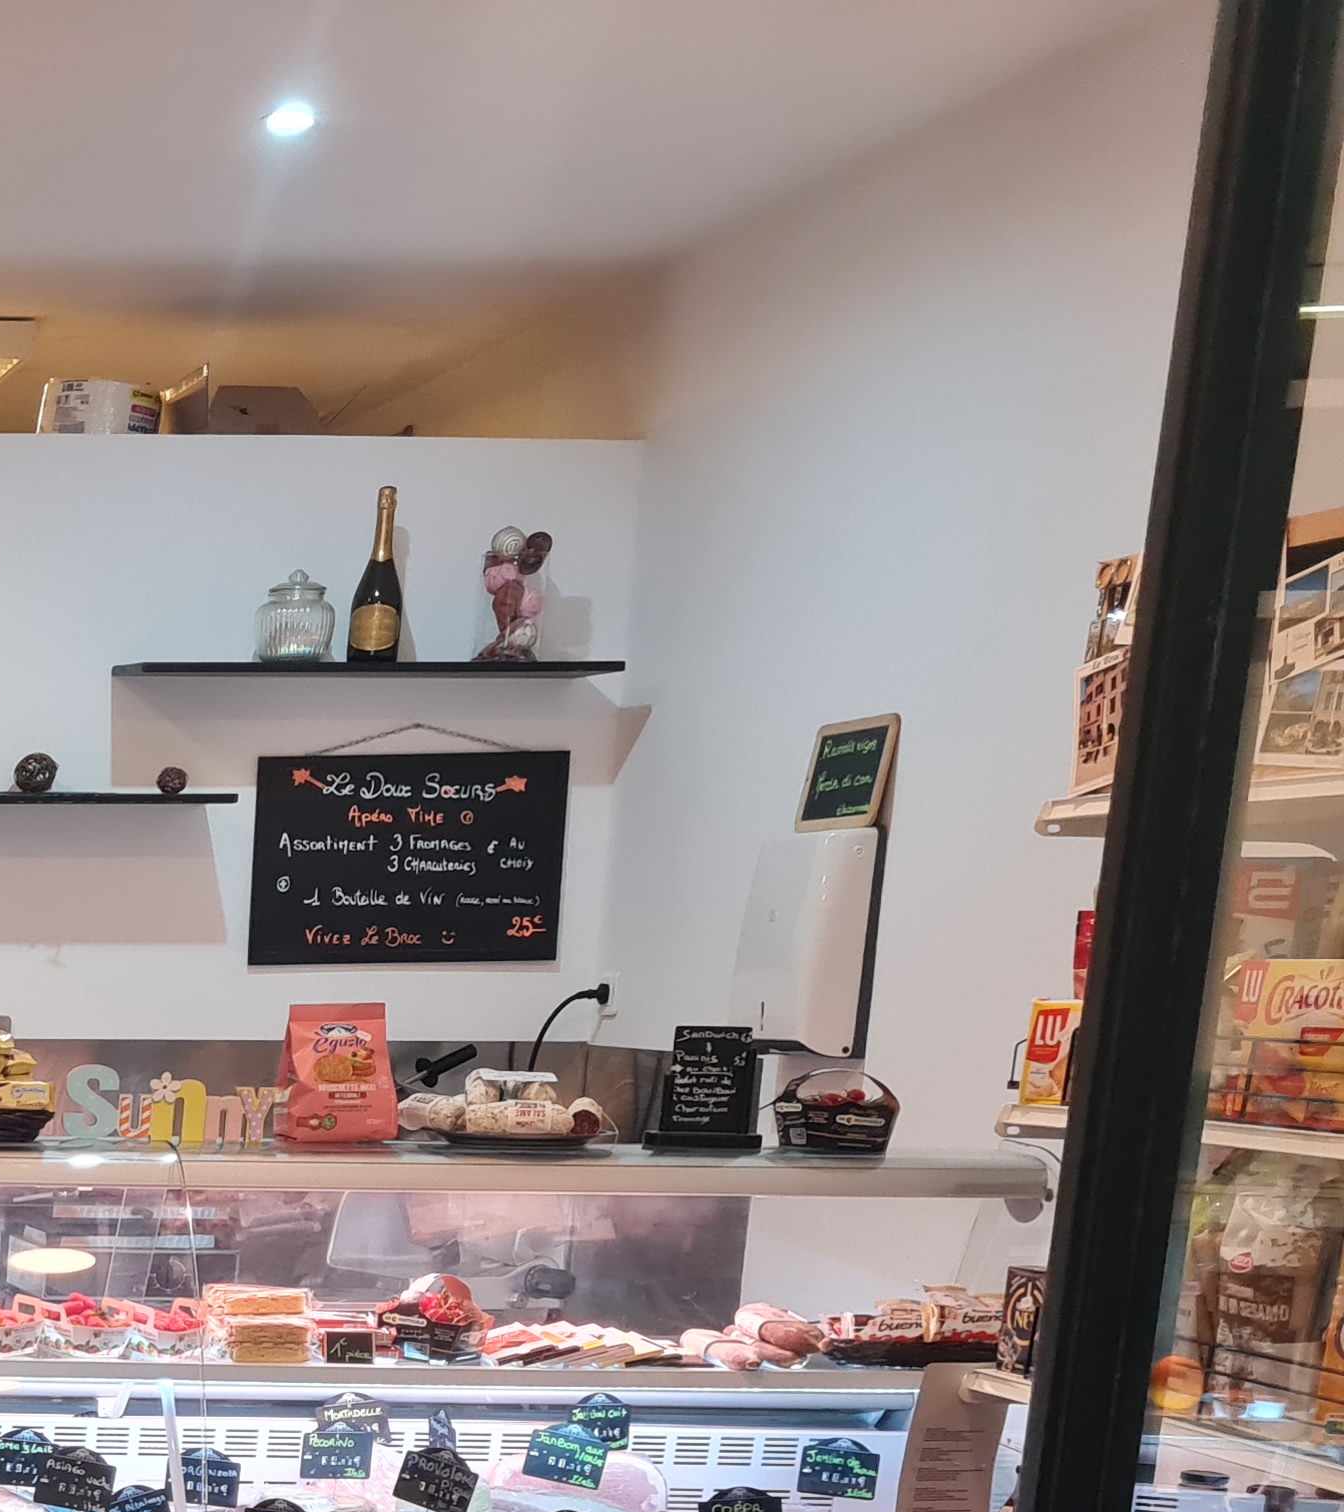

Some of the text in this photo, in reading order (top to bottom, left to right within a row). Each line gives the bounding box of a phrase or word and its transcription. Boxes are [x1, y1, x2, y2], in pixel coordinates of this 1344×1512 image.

[394, 890, 412, 907] de
[1240, 968, 1265, 1004] LU
[1035, 1014, 1062, 1047] LU
